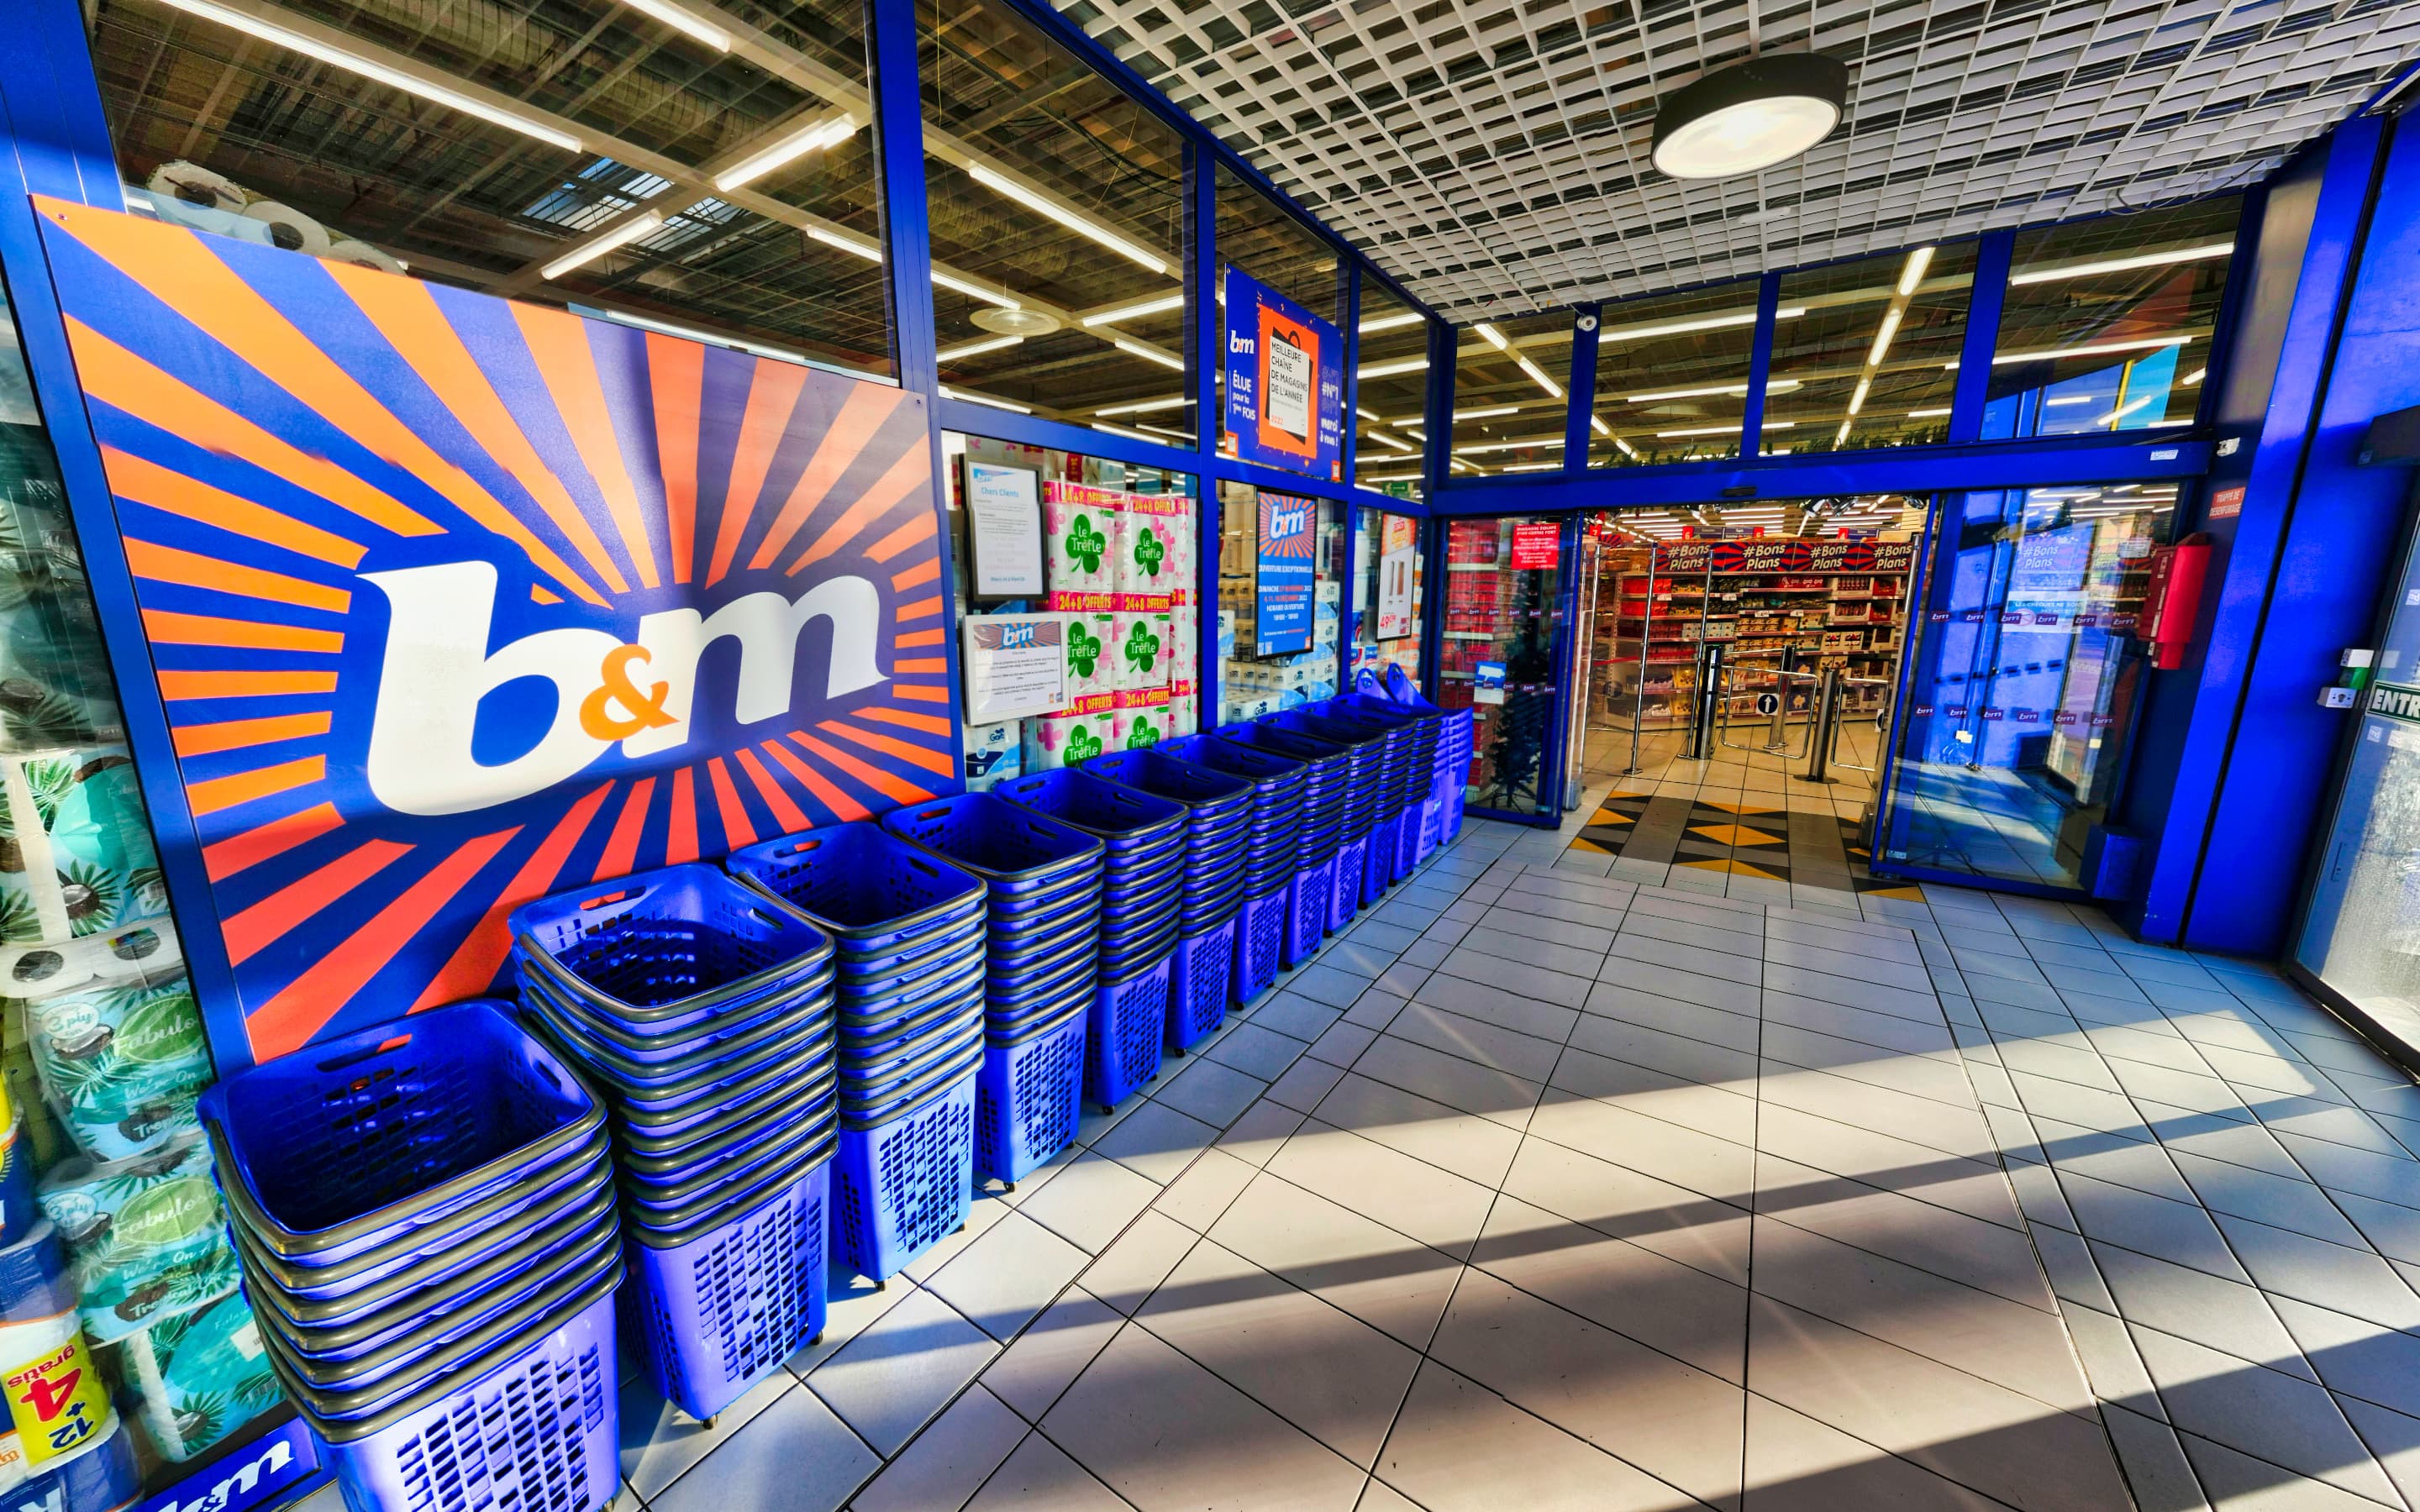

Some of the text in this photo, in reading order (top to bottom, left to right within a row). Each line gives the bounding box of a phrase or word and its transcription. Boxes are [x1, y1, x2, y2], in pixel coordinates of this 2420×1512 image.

[1271, 342, 1302, 363] MEILLEURE
[1233, 370, 1251, 392] ÉLUE
[1271, 370, 1308, 391] DE MAGASINS
[1271, 383, 1279, 395] DE
[1242, 407, 1256, 421] FOIS
[1270, 505, 1304, 538] b&m
[1071, 536, 1102, 553] Trèfle
[1667, 544, 1711, 558] #Bons
[1743, 544, 1786, 558] #Bons
[1810, 544, 1848, 558] #Bons
[1873, 544, 1912, 558] #Bons
[1138, 547, 1161, 559] Trèfle
[1670, 558, 1704, 571] Plans
[1746, 557, 1781, 570] Plans
[1812, 557, 1843, 570] Plans
[1876, 557, 1907, 570] Plans
[2024, 558, 2053, 570] Plans
[1059, 594, 1111, 610] 24+8 OFFERTS
[1124, 597, 1144, 611] 24+8
[1146, 597, 1169, 610] OFFERTS
[1068, 644, 1097, 658] Trèfle
[1130, 642, 1156, 654] Trèfle
[355, 559, 891, 816] b&m
[1086, 696, 1113, 711] OFFERTS
[1126, 690, 1169, 707] 24+8 OFFERTS
[1131, 735, 1156, 748] Trèfle
[1068, 745, 1098, 761] Trèfle
[48, 1012, 92, 1032] 3 ply
[111, 1014, 198, 1058] Fabulo
[111, 1194, 208, 1242] Fabulo
[173, 1250, 196, 1263] On
[8, 1346, 76, 1389] gratis
[21, 1368, 82, 1422] 4
[49, 1417, 94, 1450] 12
